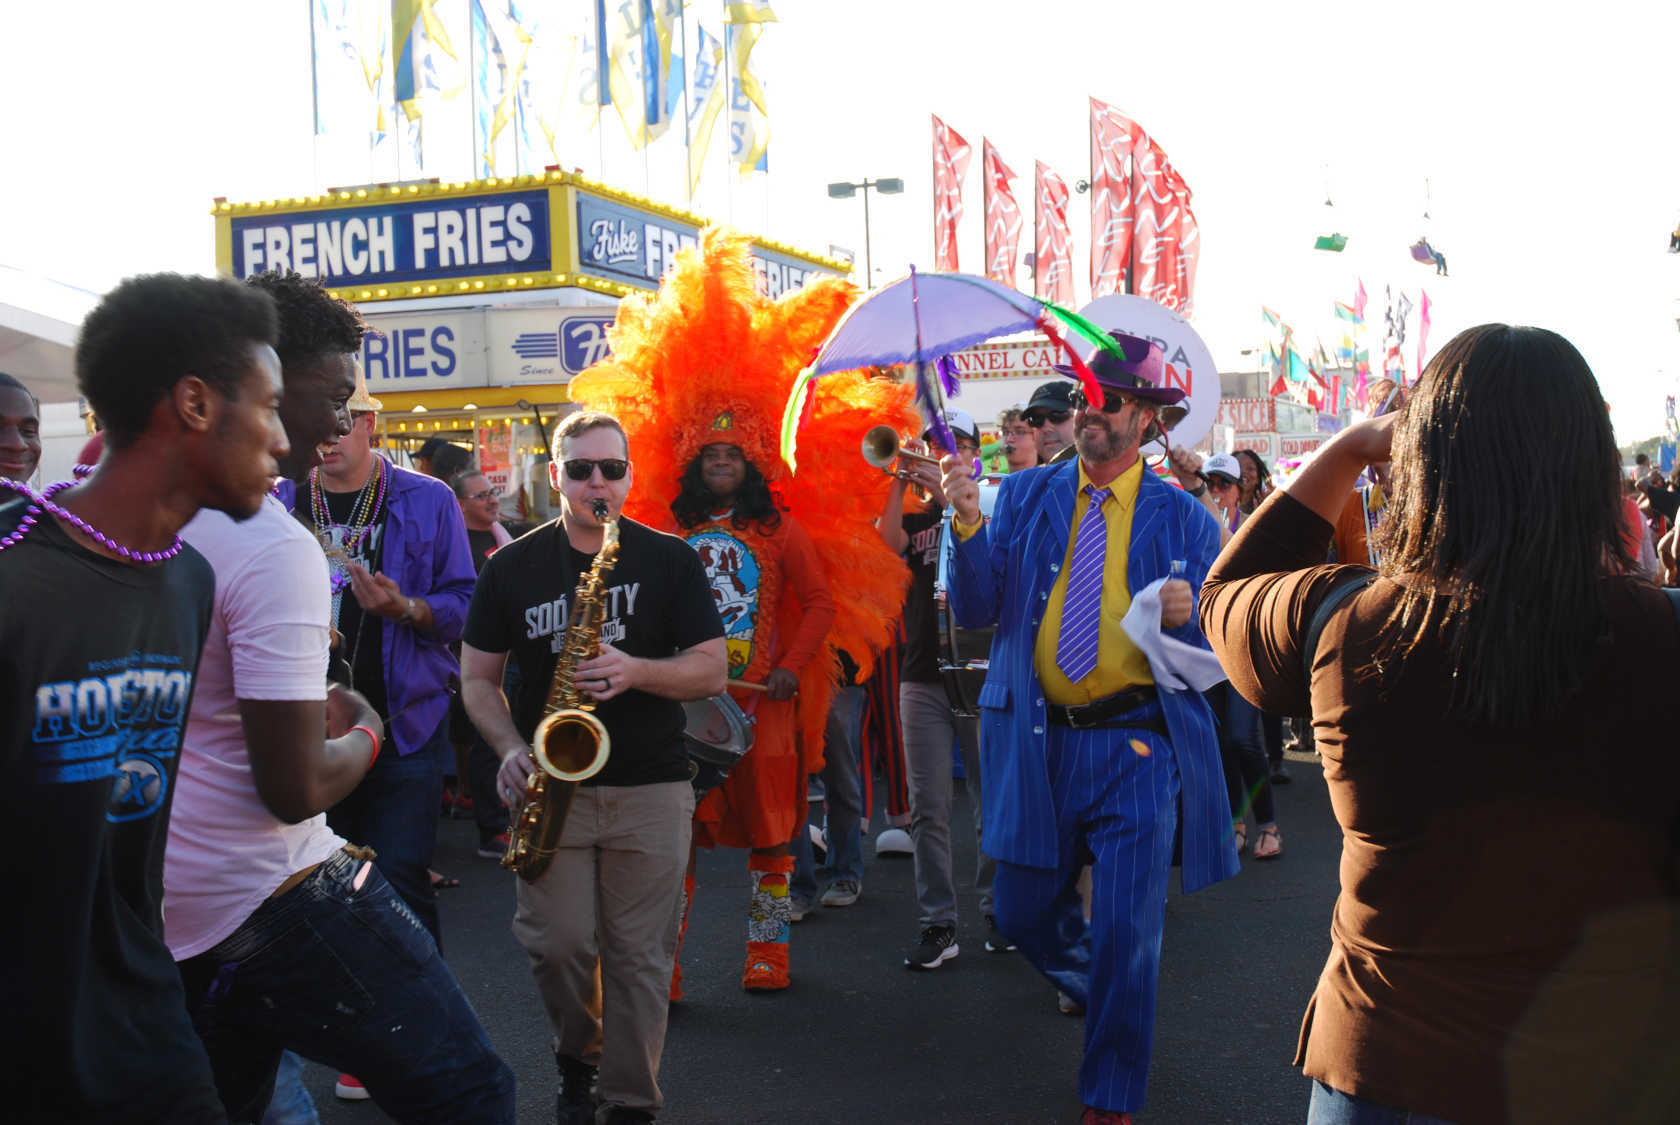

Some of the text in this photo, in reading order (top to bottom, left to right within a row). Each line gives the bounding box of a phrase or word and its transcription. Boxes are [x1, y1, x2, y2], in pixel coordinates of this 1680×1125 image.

[243, 202, 535, 278] FRENCH FRIES
[591, 220, 639, 262] Fiske
[355, 326, 457, 380] RIES
